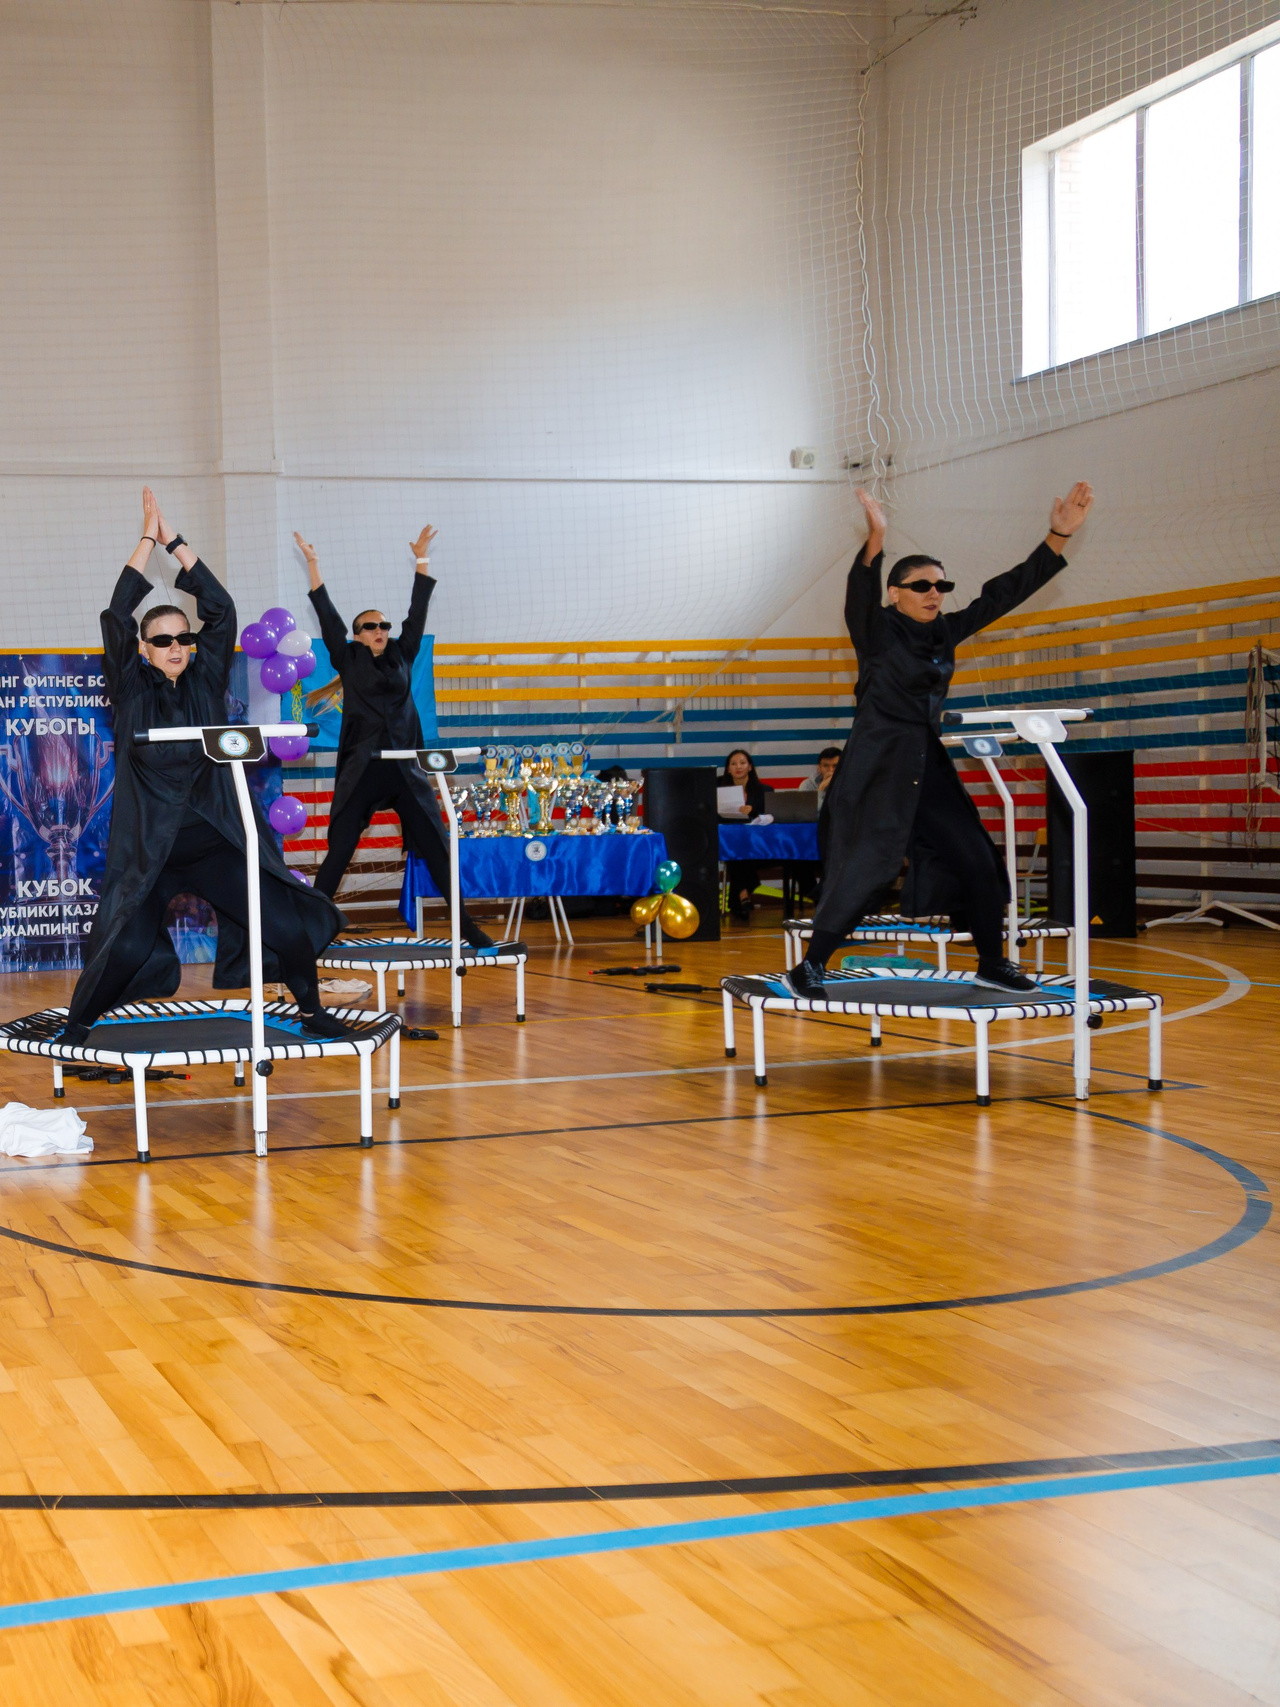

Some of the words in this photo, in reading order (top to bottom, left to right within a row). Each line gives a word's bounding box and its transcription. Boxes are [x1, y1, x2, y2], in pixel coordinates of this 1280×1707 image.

[23, 675, 84, 689] ФИТНЕС
[20, 694, 111, 708] РЕСПУБЛИКА
[6, 717, 96, 736] КУБОГЫ
[18, 878, 94, 898] КУБОК
